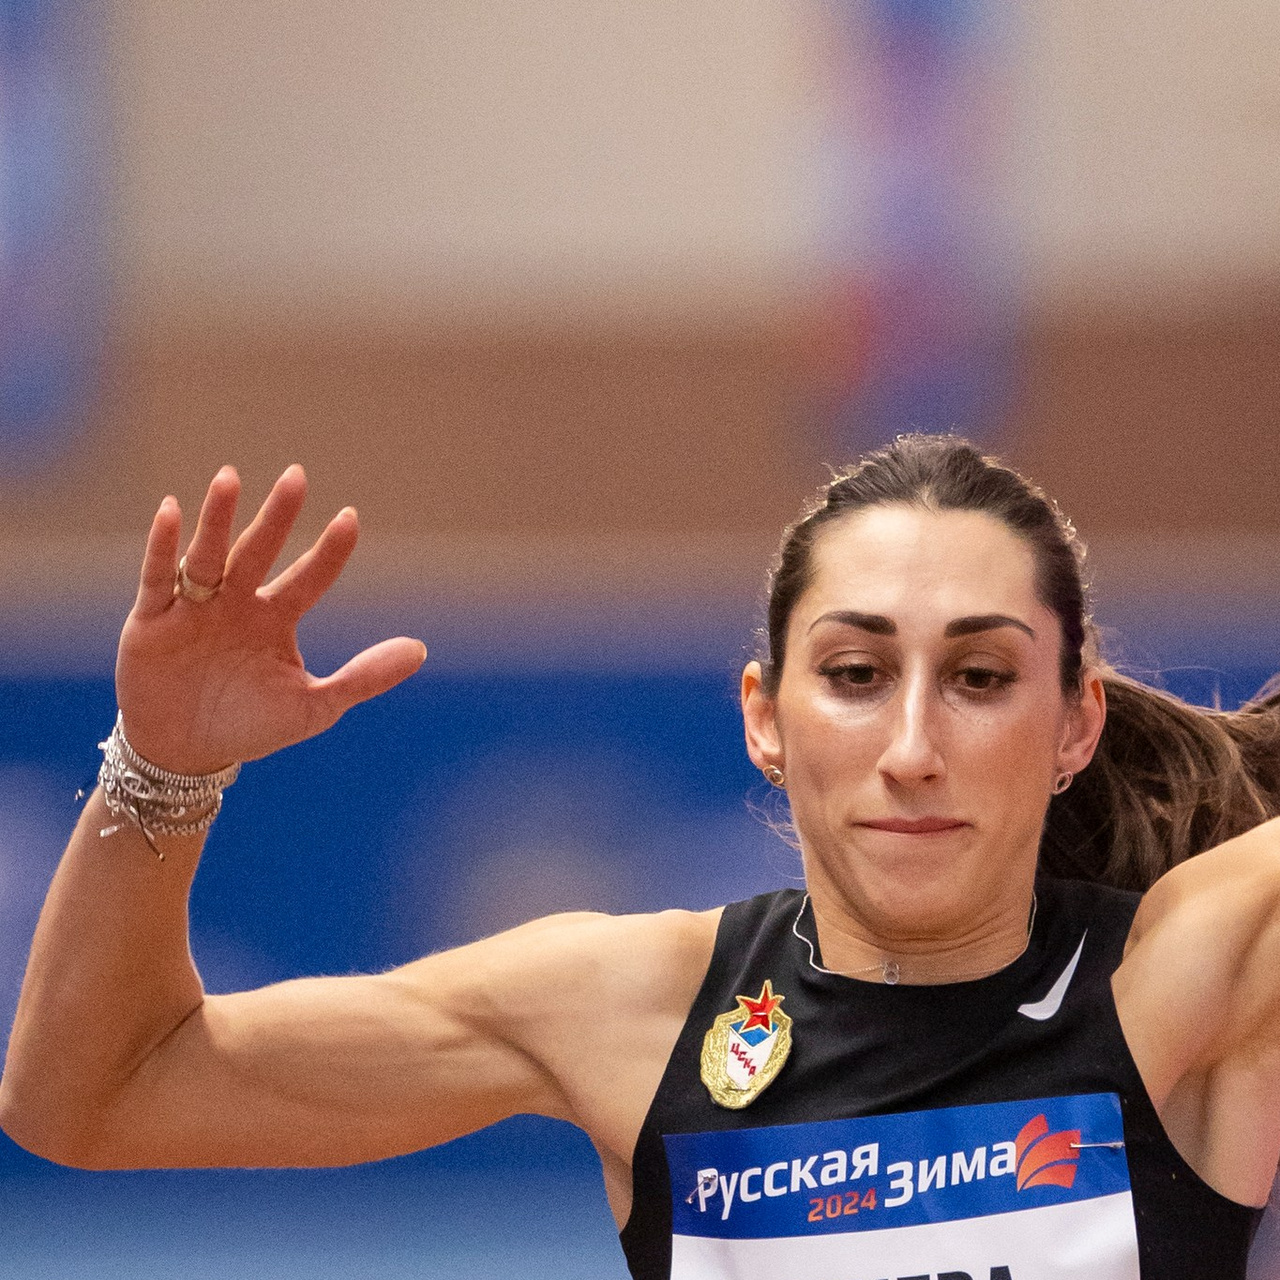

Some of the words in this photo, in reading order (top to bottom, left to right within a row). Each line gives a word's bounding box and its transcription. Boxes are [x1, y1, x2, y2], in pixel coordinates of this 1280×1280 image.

[730, 1043, 756, 1076] ЦСКА
[697, 1143, 879, 1220] Русская
[884, 1141, 1017, 1208] Зима
[808, 1188, 877, 1222] 2024
